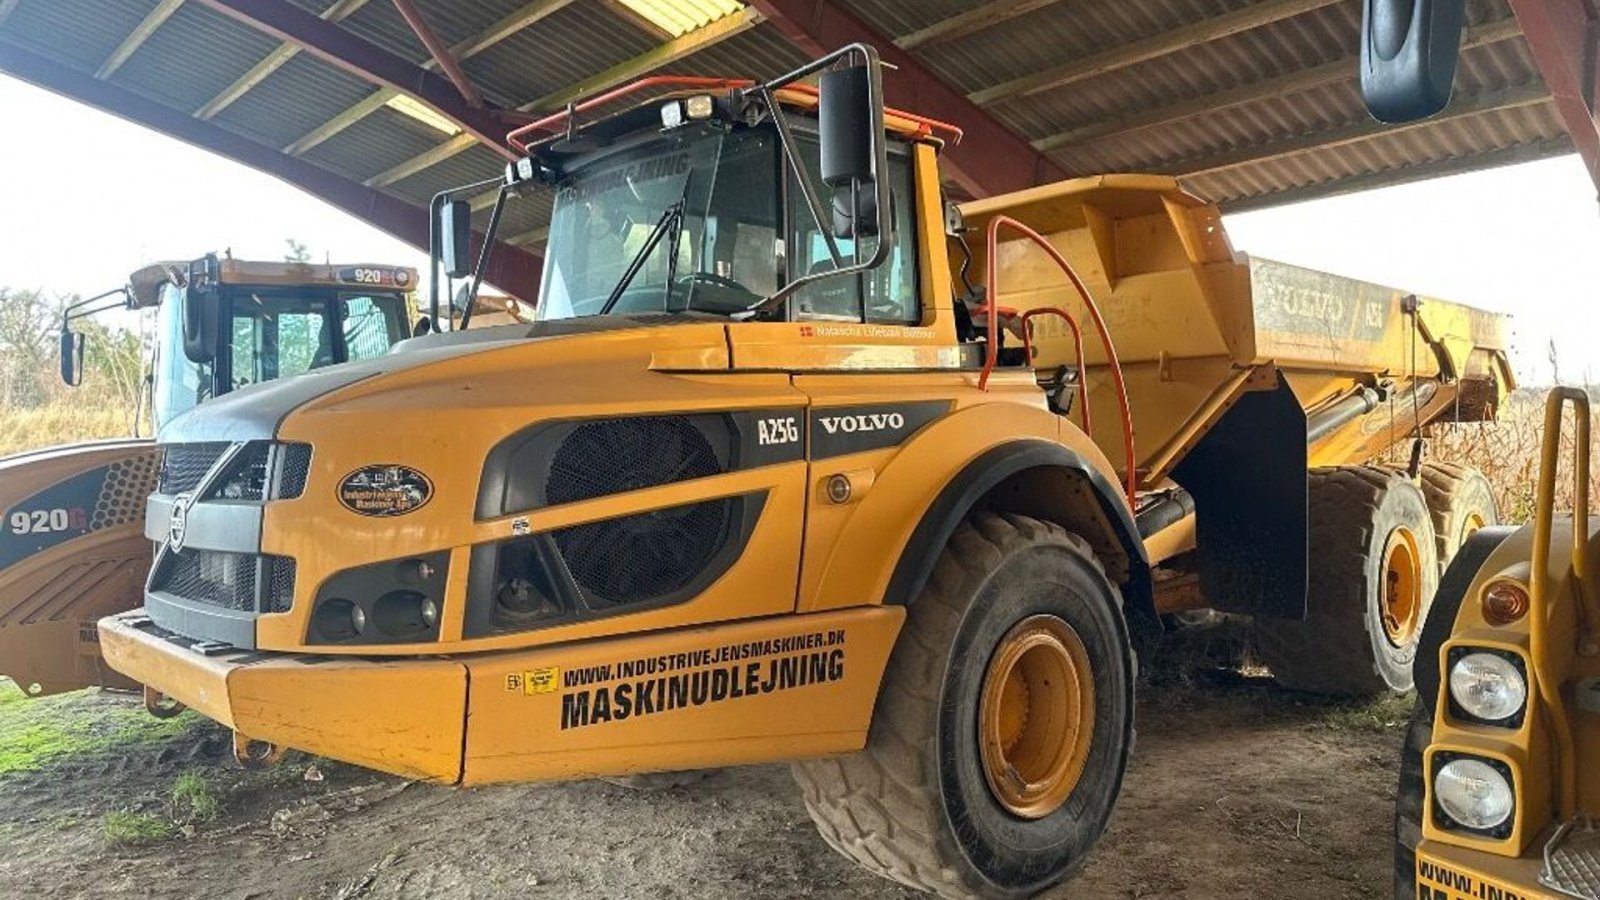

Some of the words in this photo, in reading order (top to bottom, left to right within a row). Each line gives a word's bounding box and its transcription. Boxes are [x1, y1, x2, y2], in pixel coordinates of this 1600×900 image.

[758, 417, 798, 445] A25G
[819, 413, 904, 434] VOLVO
[10, 506, 87, 535] 920G
[564, 630, 845, 687] WWW.INDUSTRIVEJENSMASKINER.DK
[561, 649, 844, 730] MASKINUDLEJNING
[1418, 859, 1528, 900] WWW.IN
